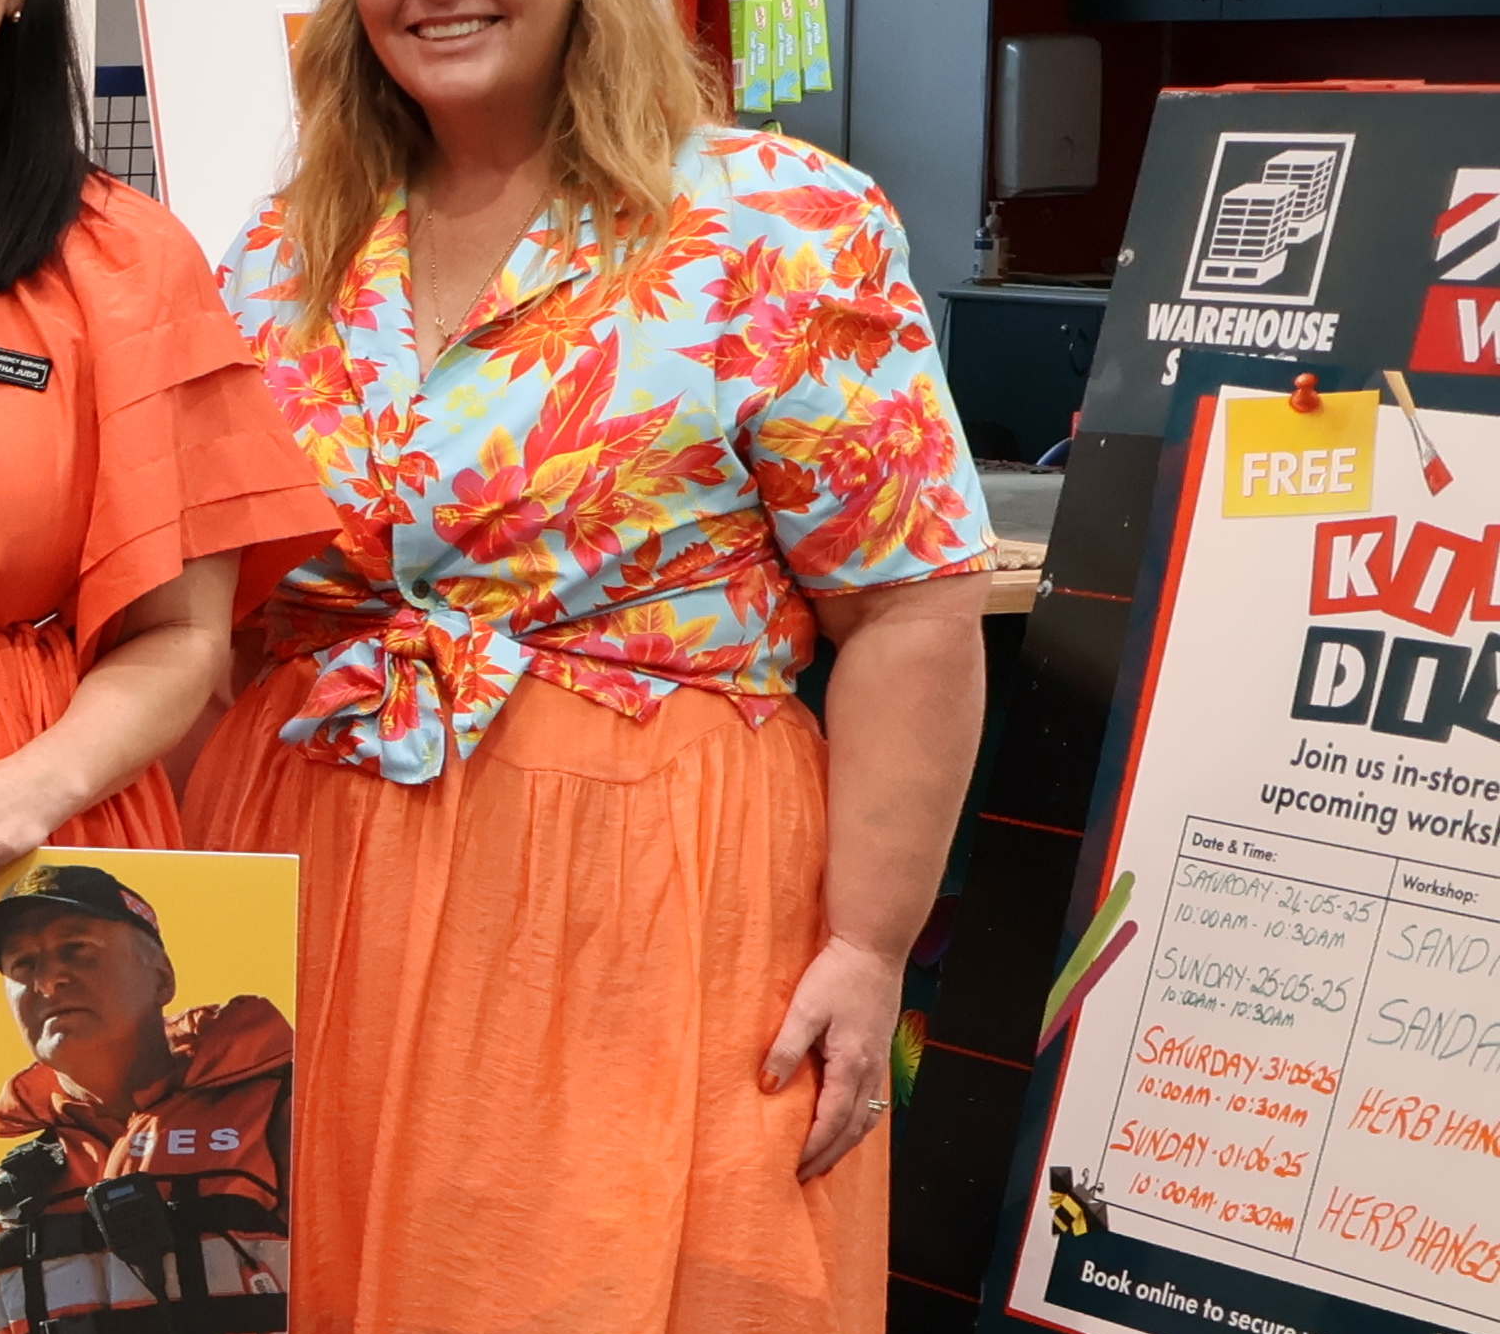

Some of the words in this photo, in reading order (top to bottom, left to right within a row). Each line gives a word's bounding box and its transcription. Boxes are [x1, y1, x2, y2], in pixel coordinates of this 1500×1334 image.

[1147, 303, 1339, 352] WAREHOUSE
[1242, 447, 1357, 497] FREE
[1328, 531, 1500, 614] KI
[1290, 738, 1348, 774] Join
[1355, 757, 1385, 781] us
[1392, 753, 1500, 802] in-store
[1261, 783, 1398, 836] upcoming
[1407, 809, 1500, 847] works
[1192, 832, 1223, 852] Date
[1227, 841, 1238, 854] &
[1242, 842, 1278, 863] Time:
[1402, 874, 1480, 905] Workshop:
[1388, 924, 1500, 977] SAND
[129, 1127, 241, 1157] SES
[1081, 1260, 1131, 1296] Book
[1136, 1282, 1199, 1315] online
[1202, 1298, 1224, 1323] to
